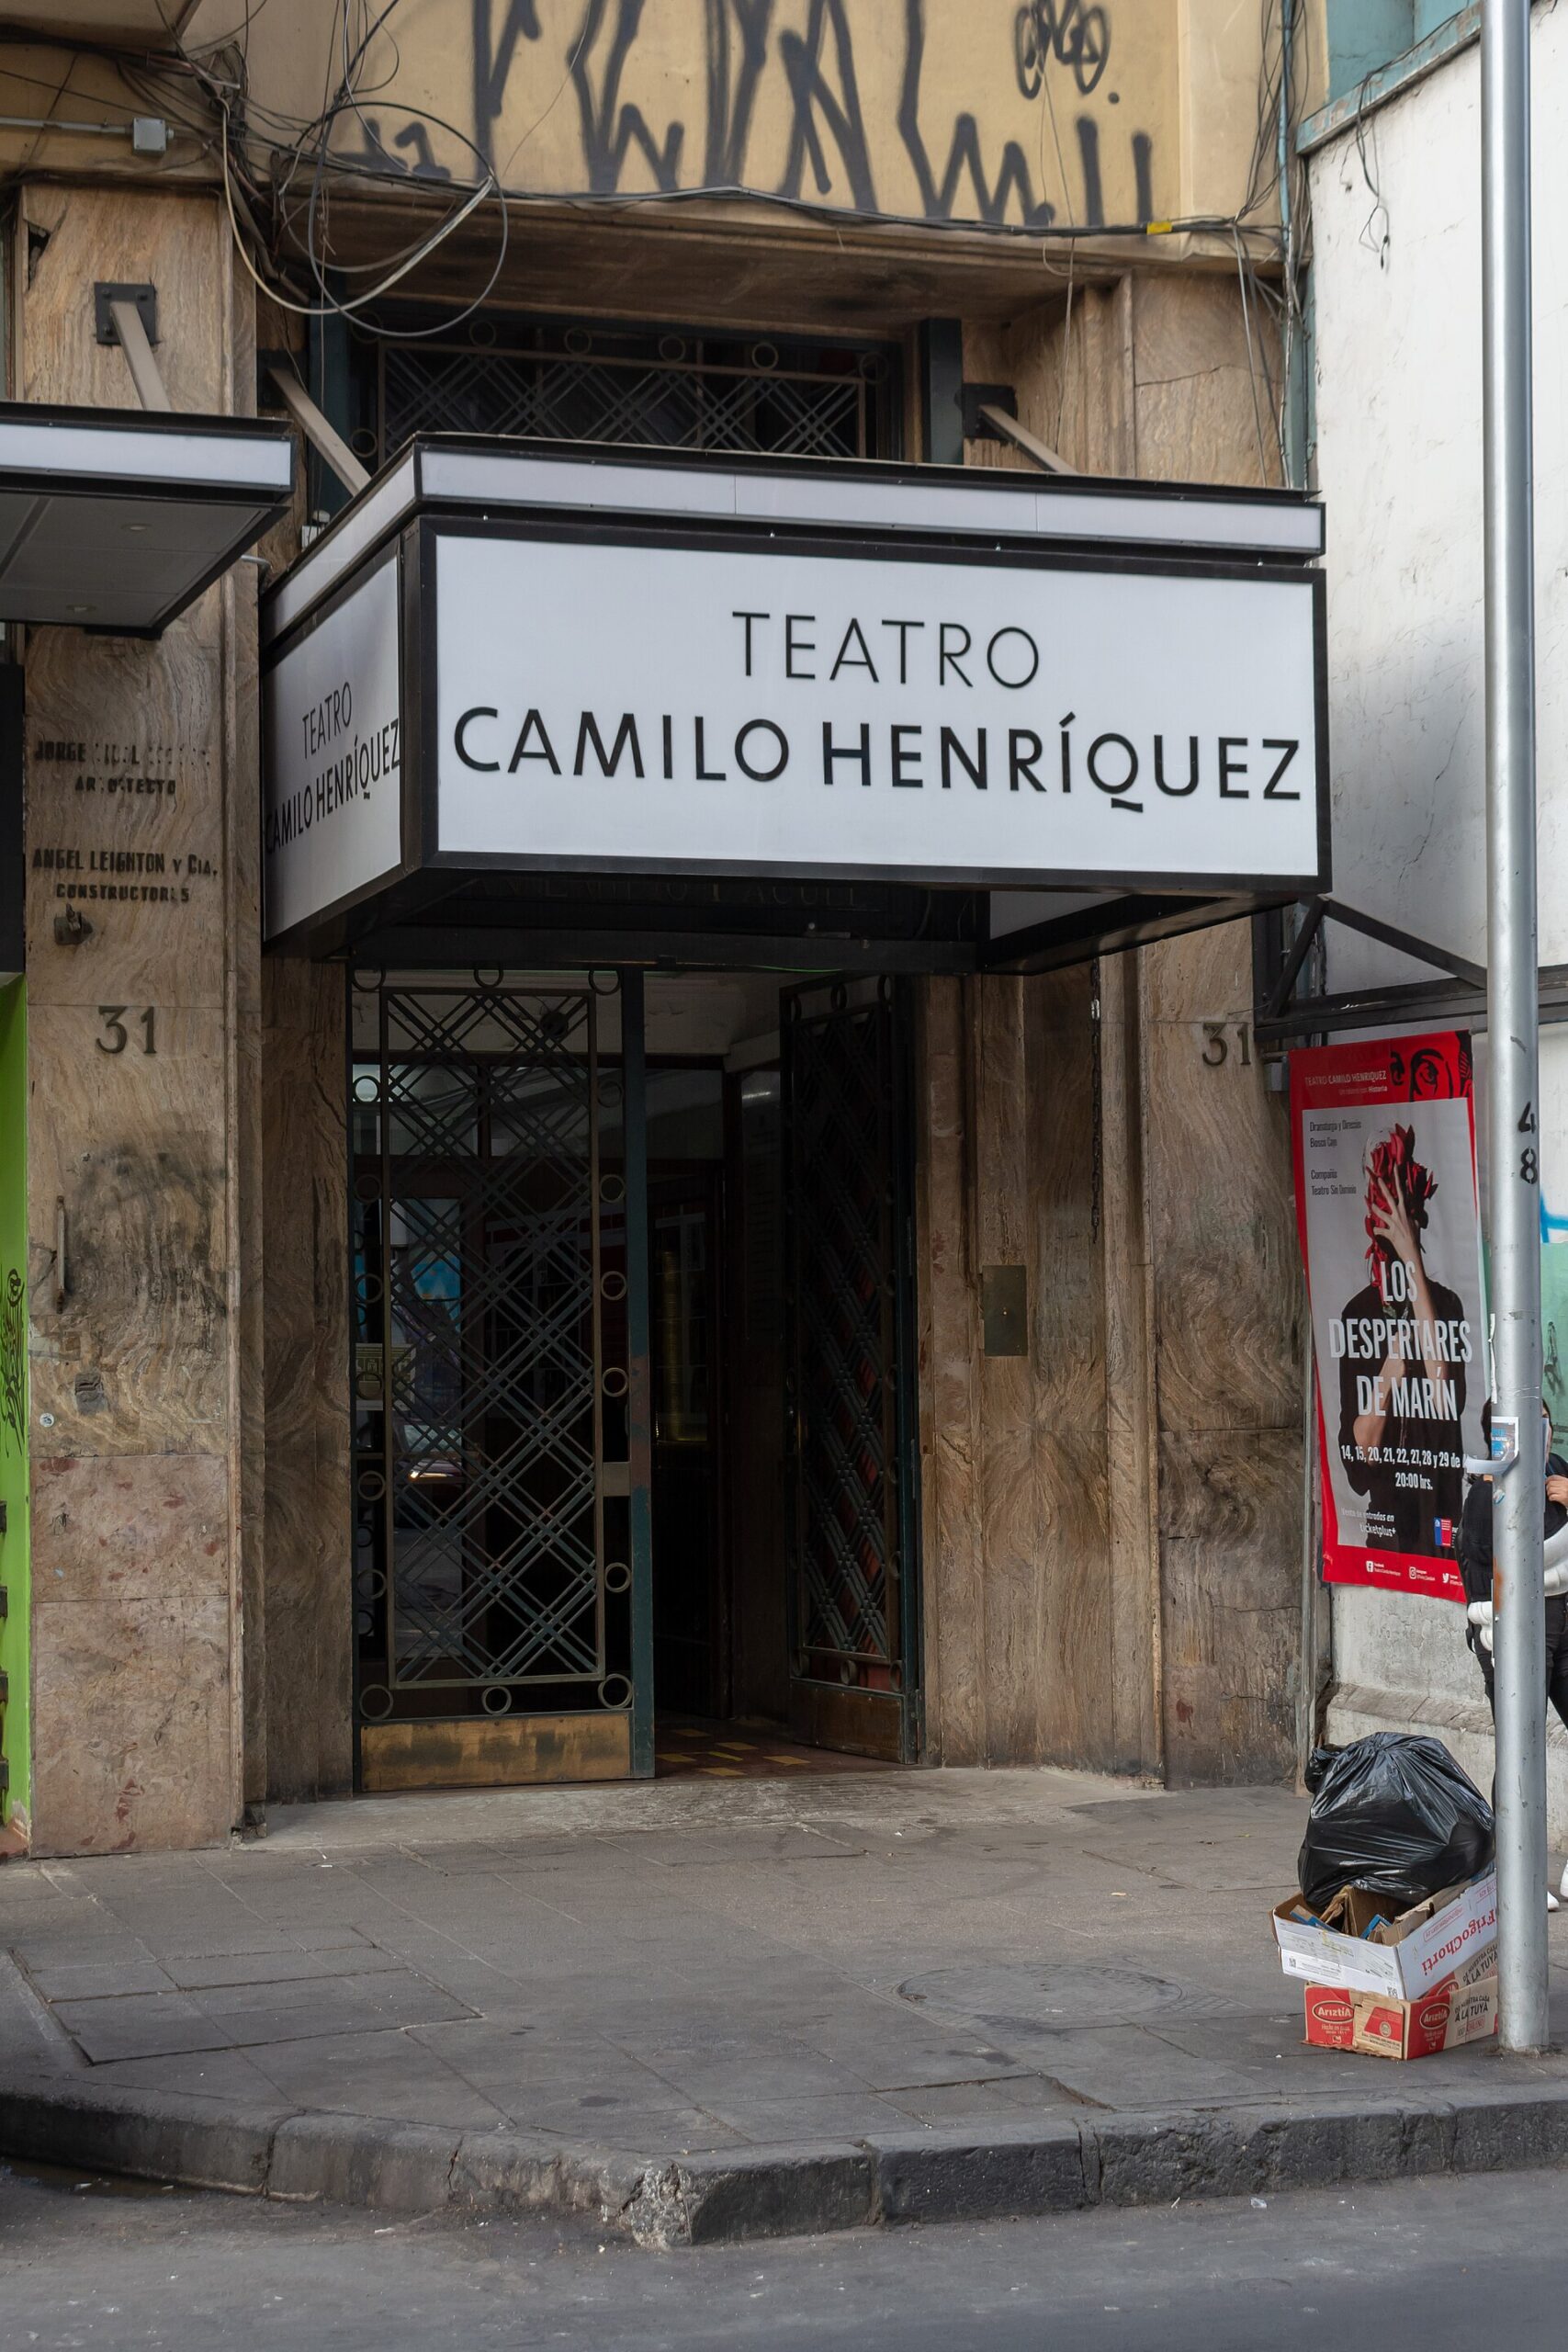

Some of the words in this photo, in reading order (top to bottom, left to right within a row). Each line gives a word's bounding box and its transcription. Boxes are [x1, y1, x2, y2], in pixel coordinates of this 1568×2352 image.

[732, 610, 1039, 689] TEATRO
[301, 681, 353, 760] TEATRO
[33, 741, 87, 763] JORGE
[316, 718, 400, 822] HENRÍQUEZ
[454, 706, 790, 782] CAMILO
[822, 710, 1301, 813] HENRÍQUEZ
[32, 848, 84, 871] ANGEL
[90, 849, 165, 875] LEIGHTON
[96, 1005, 158, 1056] 31
[1201, 1022, 1252, 1067] 31
[1328, 1073, 1351, 1085] CAMILO
[1311, 1185, 1330, 1195] Teatro
[1380, 1261, 1418, 1303] LOS
[1328, 1317, 1472, 1363] DESPERTARES
[1356, 1374, 1386, 1417] DE
[1391, 1366, 1459, 1421] MARÍN
[1340, 1444, 1354, 1462] 14,
[1355, 1445, 1367, 1463] 15,
[1368, 1446, 1382, 1464] 20,
[1382, 1447, 1395, 1464] 21,
[1396, 1448, 1410, 1466] 22,
[1410, 1448, 1422, 1467] 27,
[1422, 1449, 1432, 1466] 28
[1433, 1454, 1438, 1469] y
[1438, 1451, 1450, 1468] 29
[1450, 1452, 1461, 1468] de
[1394, 1471, 1419, 1488] 20:00
[1419, 1473, 1434, 1490] hrs.
[1386, 1513, 1394, 1522] en
[1471, 1968, 1481, 1984] LA
[1480, 1950, 1498, 1973] TUYA
[1454, 2012, 1461, 2023] A
[1461, 2008, 1469, 2020] LA
[1470, 2001, 1489, 2017] TUYA
